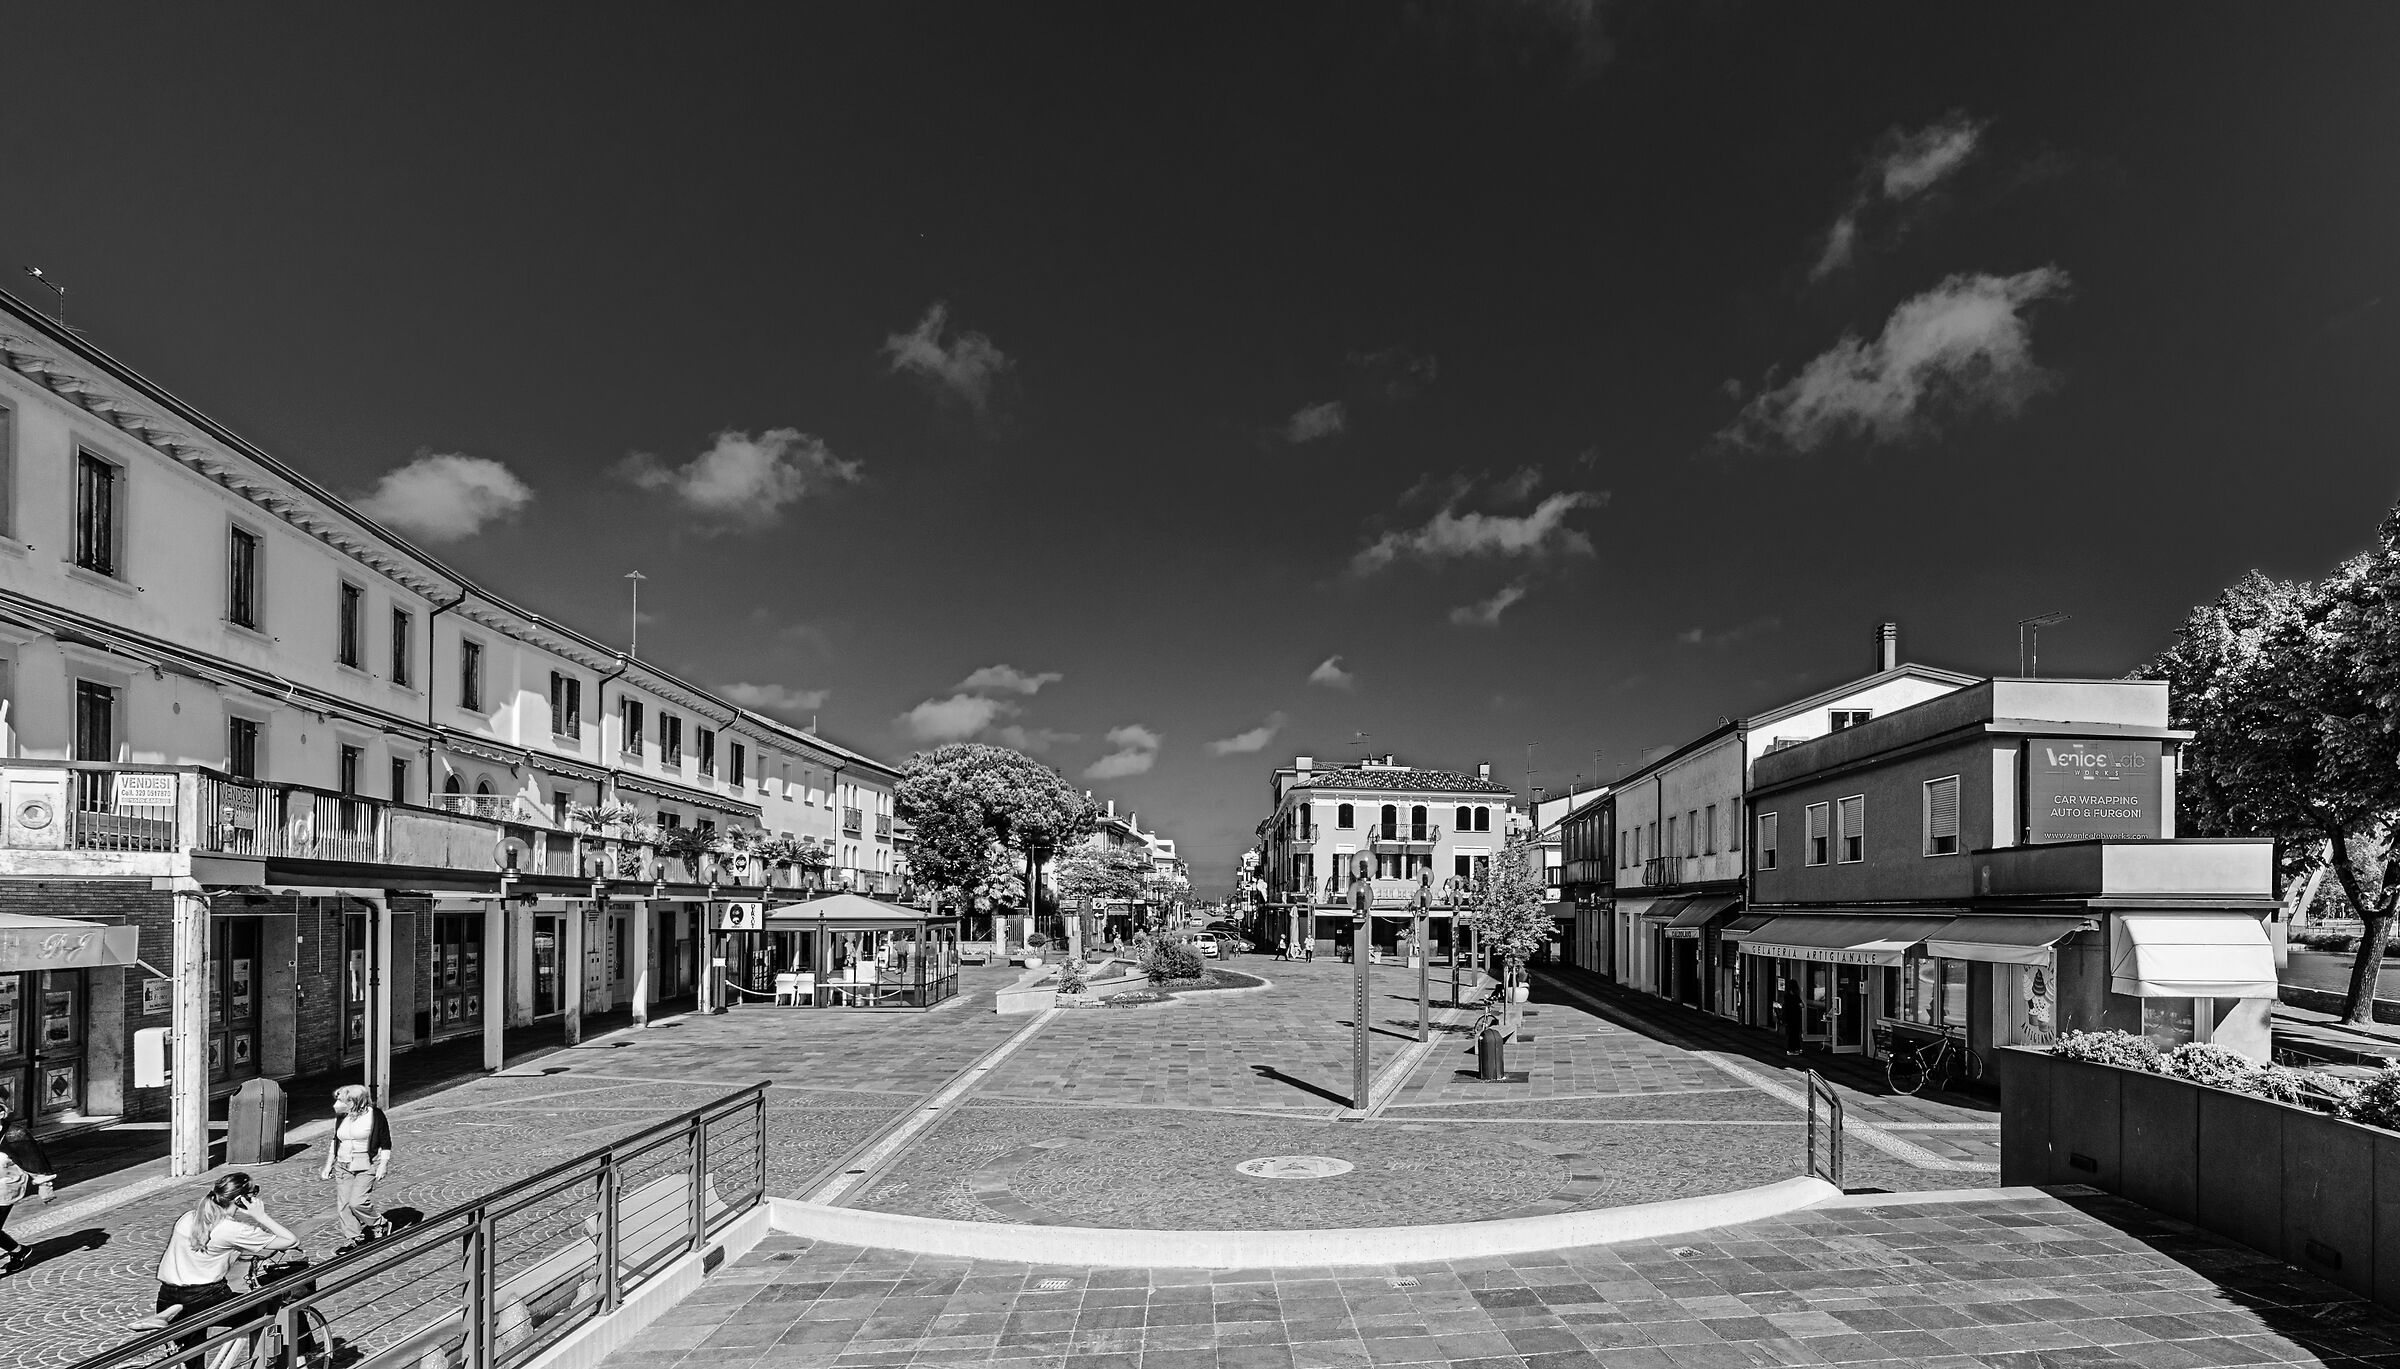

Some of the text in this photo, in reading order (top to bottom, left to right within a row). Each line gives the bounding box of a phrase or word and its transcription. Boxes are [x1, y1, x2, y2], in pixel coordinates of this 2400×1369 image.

[121, 777, 170, 789] VENDESI
[220, 784, 254, 805] VENDESI
[2054, 795, 2138, 805] CAR WRAPPING
[2050, 808, 2142, 818] AUTO & FURGONI
[1752, 945, 1876, 964] GELATERIA ARTIGIANALE
